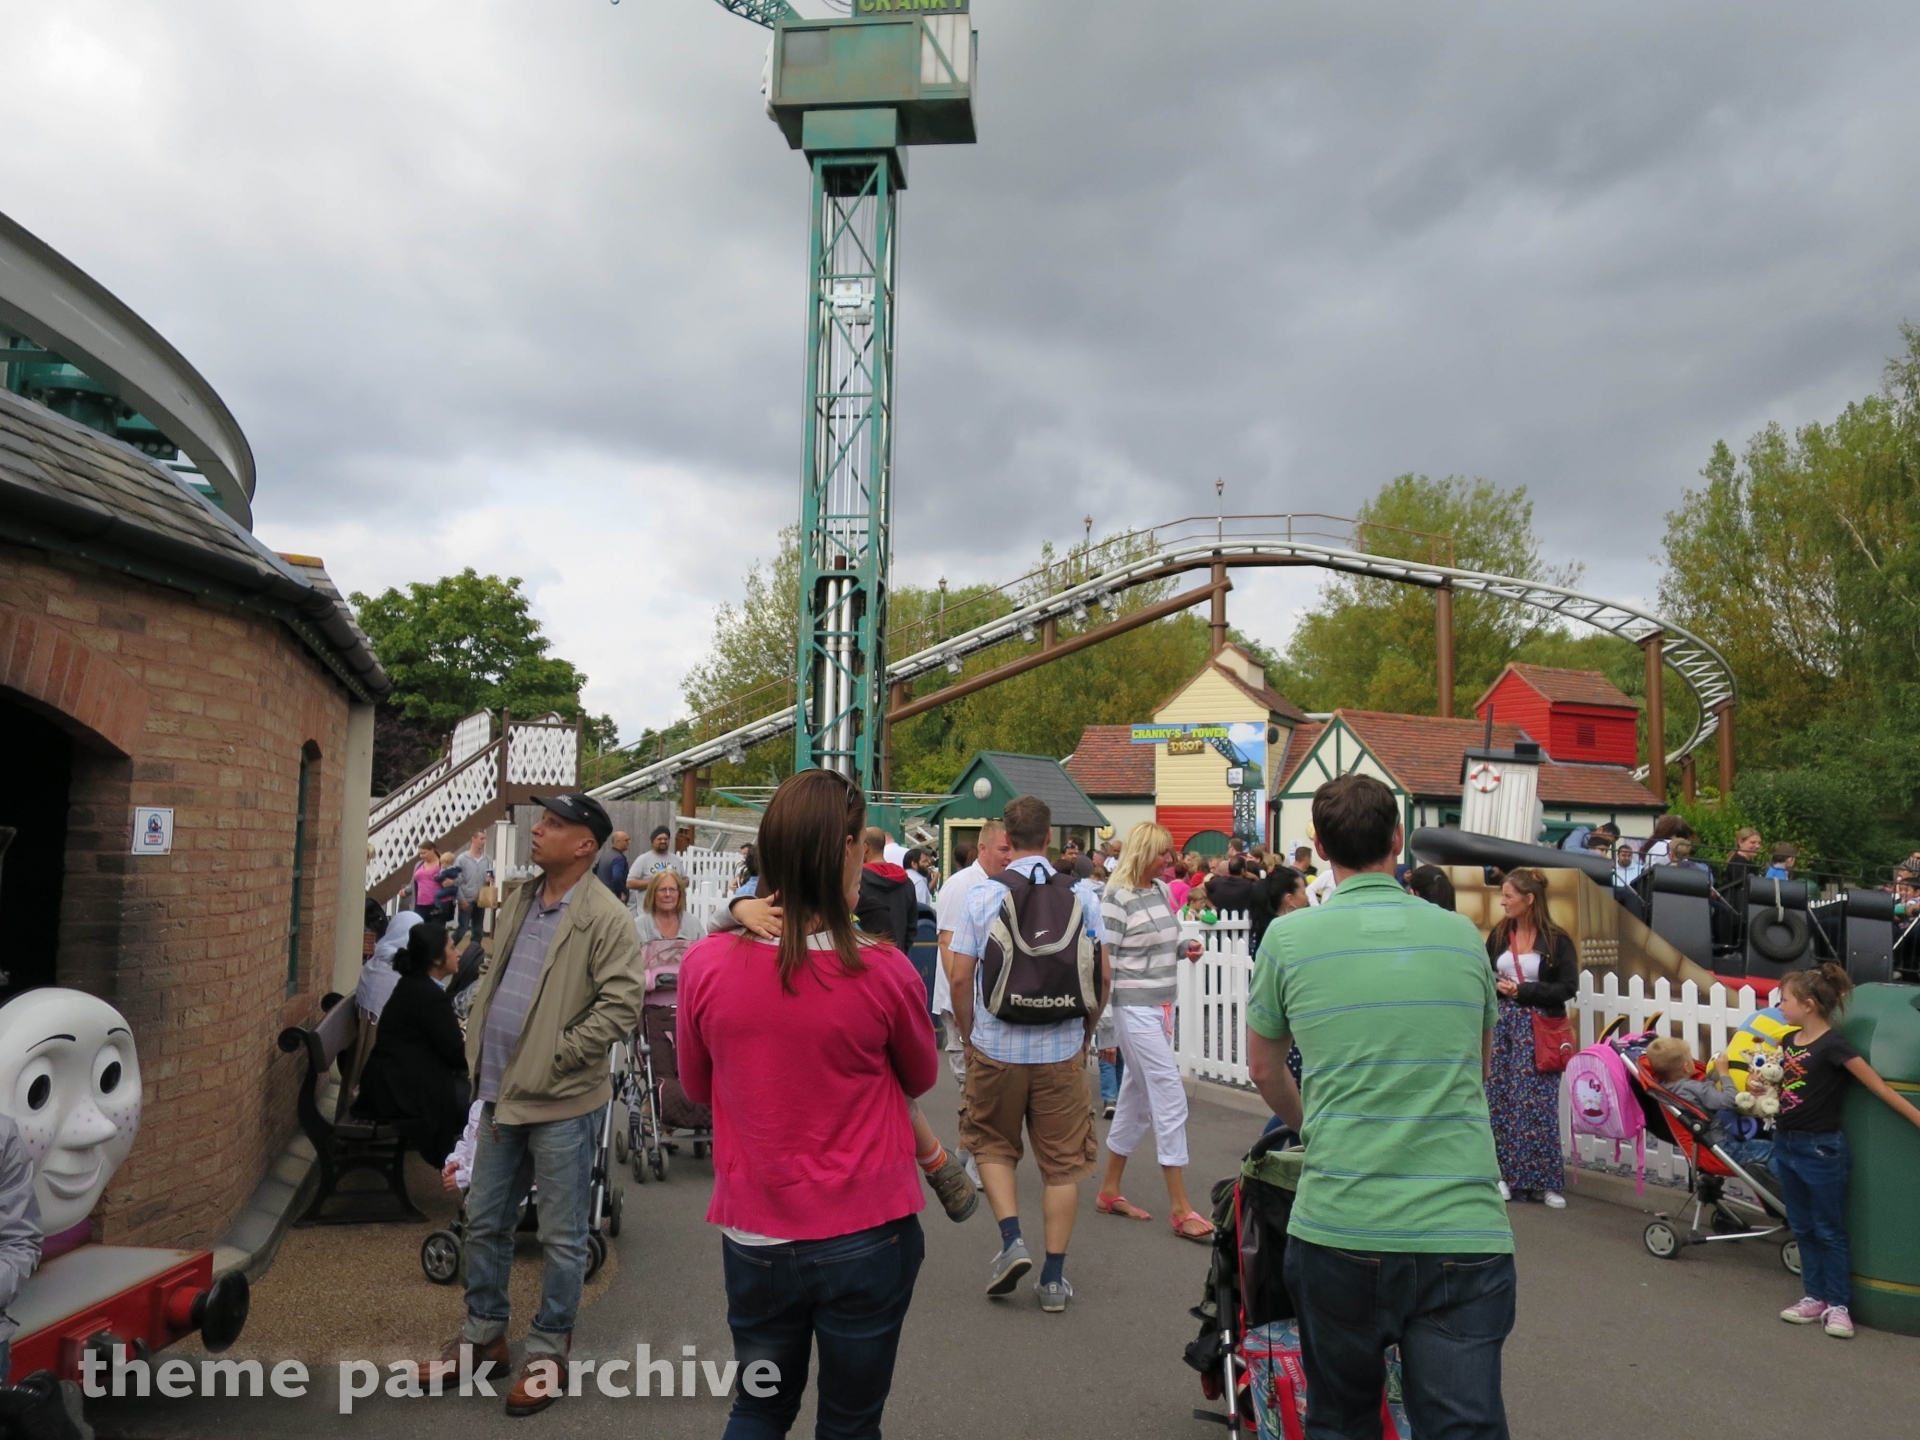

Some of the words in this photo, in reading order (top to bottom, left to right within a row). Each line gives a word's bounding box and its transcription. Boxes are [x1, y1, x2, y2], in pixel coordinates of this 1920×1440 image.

[1132, 728, 1182, 739] CRANKY'S
[1191, 728, 1228, 738] TOWER
[1170, 740, 1203, 752] DROP
[1010, 993, 1077, 1008] Reebok
